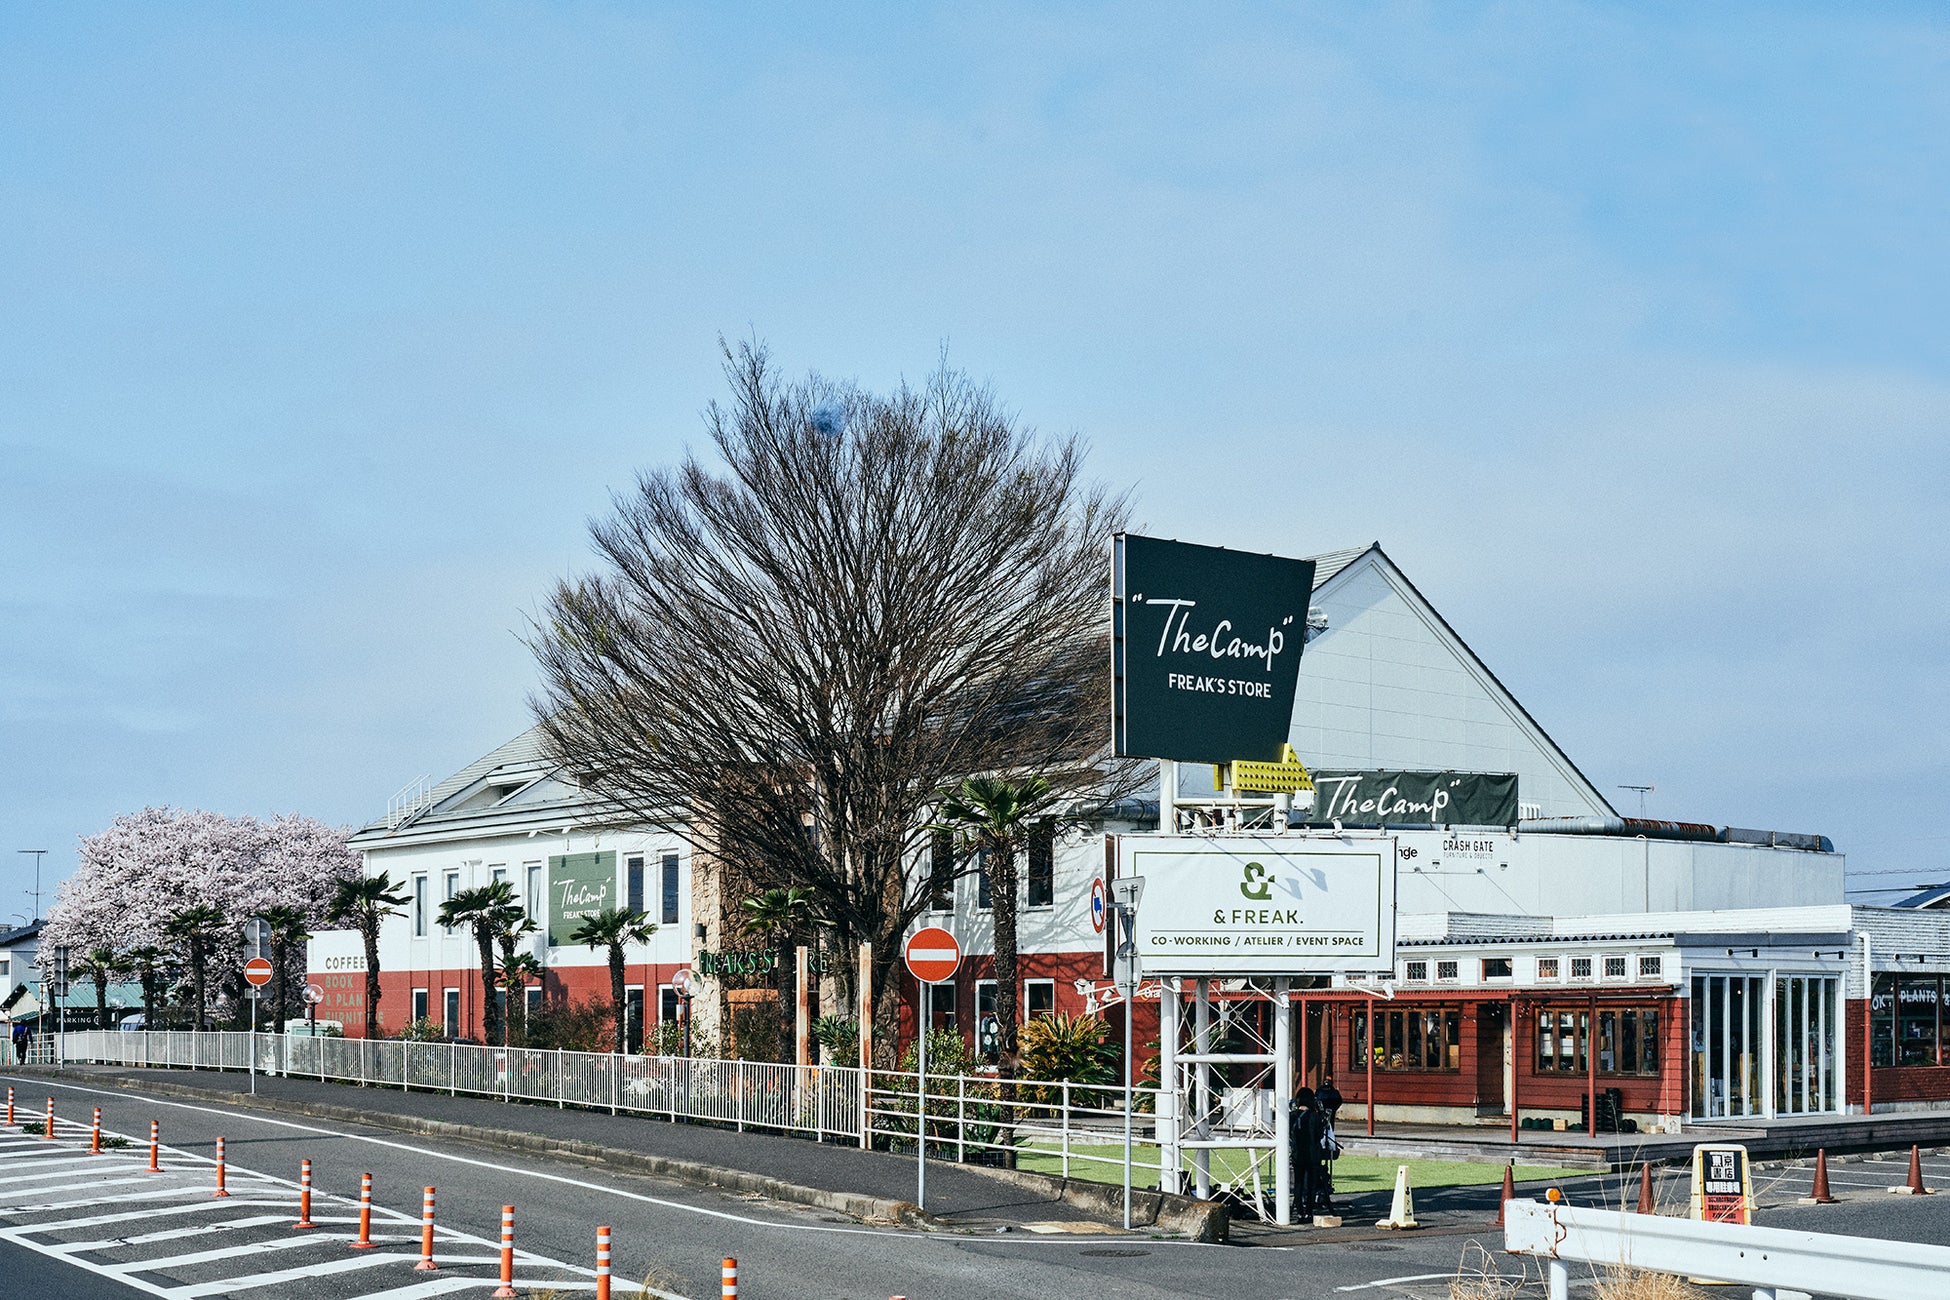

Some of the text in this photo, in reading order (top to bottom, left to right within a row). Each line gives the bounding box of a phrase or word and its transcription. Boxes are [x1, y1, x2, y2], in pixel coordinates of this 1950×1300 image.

[1168, 673, 1272, 698] FREAK'S STORE
[1398, 847, 1419, 860] nge
[1443, 840, 1494, 853] CRASH GATE
[1213, 909, 1304, 924] & FREAK.
[1243, 936, 1284, 946] ATELIER
[1296, 936, 1329, 946] EVENT
[1331, 936, 1364, 946] SPACE
[325, 956, 365, 970] COFFEE
[761, 948, 830, 975] SRE
[325, 975, 354, 989] BOOK
[1900, 989, 1938, 1004] PLANTS
[325, 1011, 384, 1025] FURNITE
